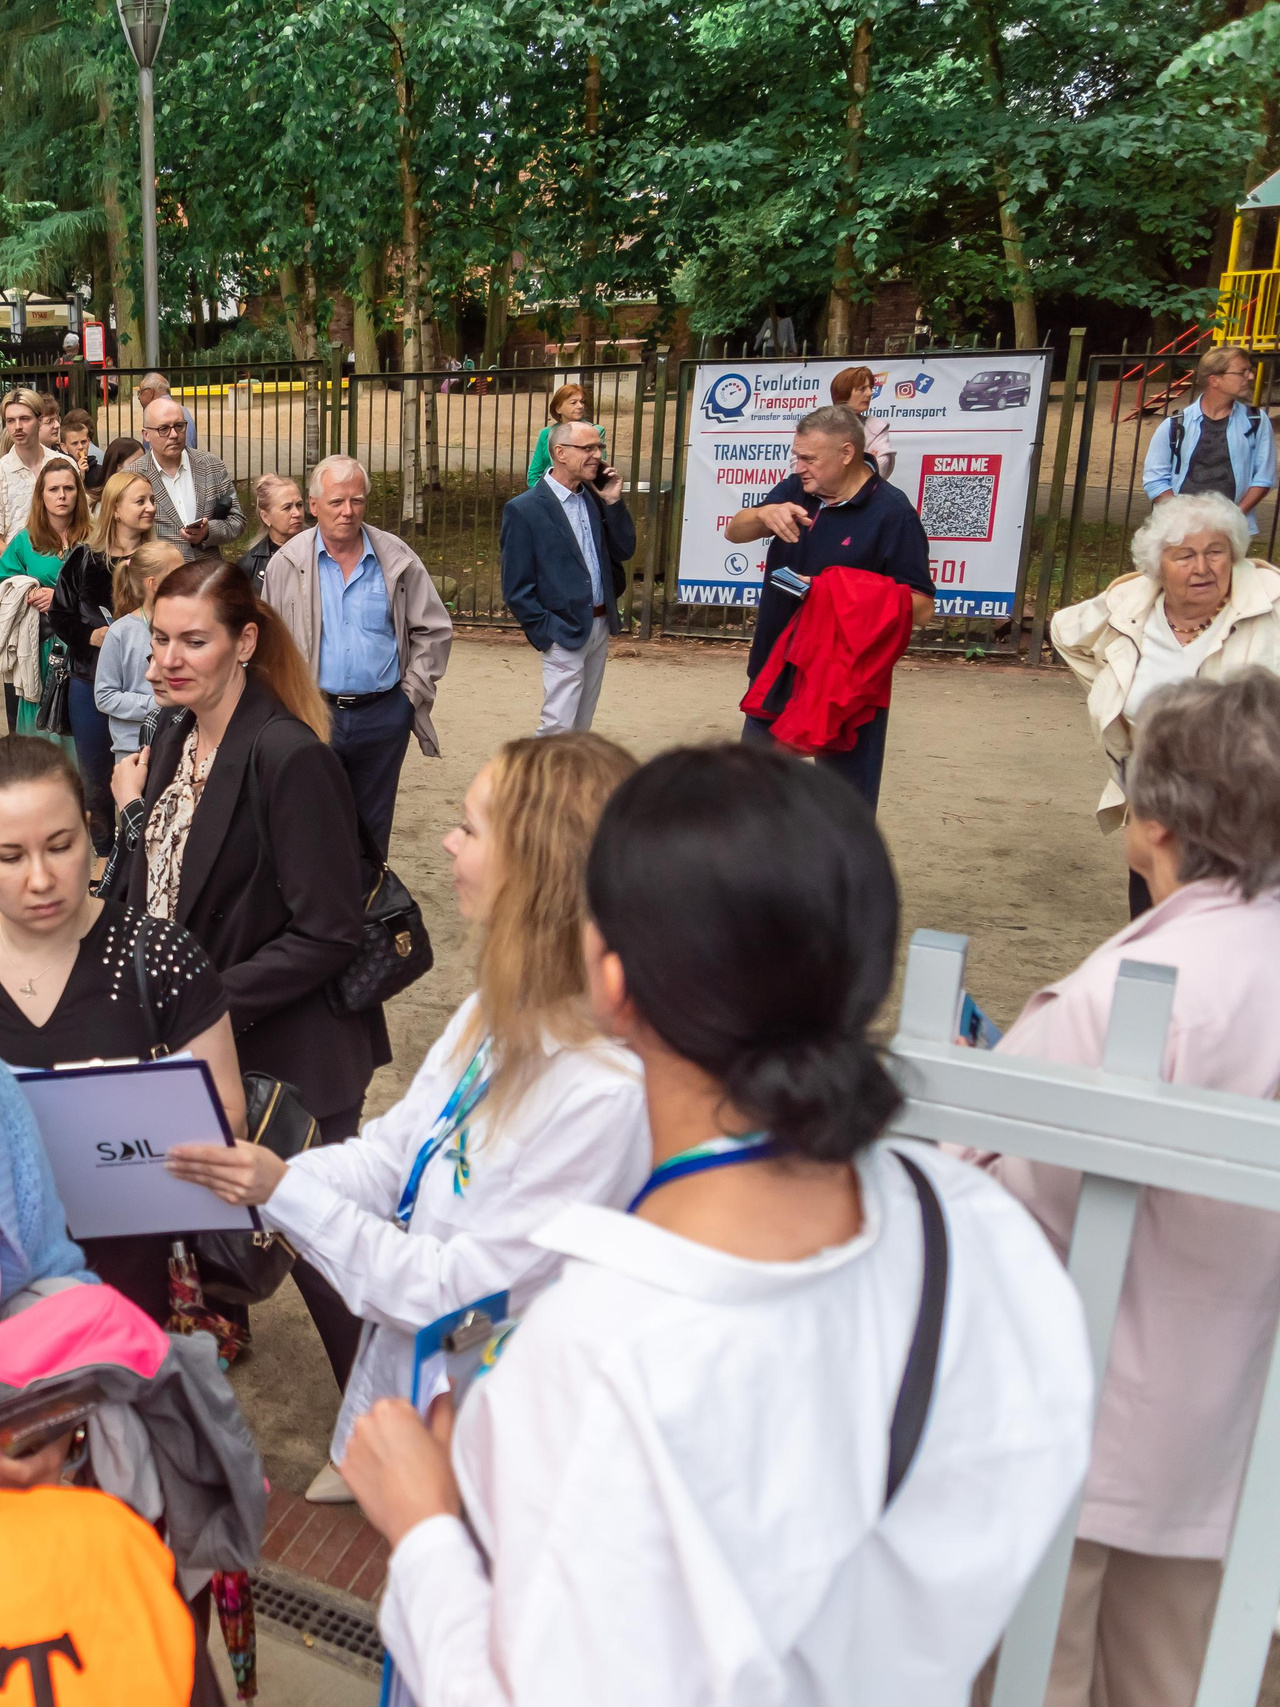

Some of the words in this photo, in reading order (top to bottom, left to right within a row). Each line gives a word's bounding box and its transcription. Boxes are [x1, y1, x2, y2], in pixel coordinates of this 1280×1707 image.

[754, 374, 820, 391] Evolution
[753, 392, 818, 412] Transport
[751, 413, 781, 421] transfer
[714, 444, 791, 461] TRANSFERY
[933, 458, 968, 472] SCAN
[970, 458, 989, 472] ME
[716, 468, 786, 485] PODMIANY
[933, 596, 1008, 616] evtr.eu
